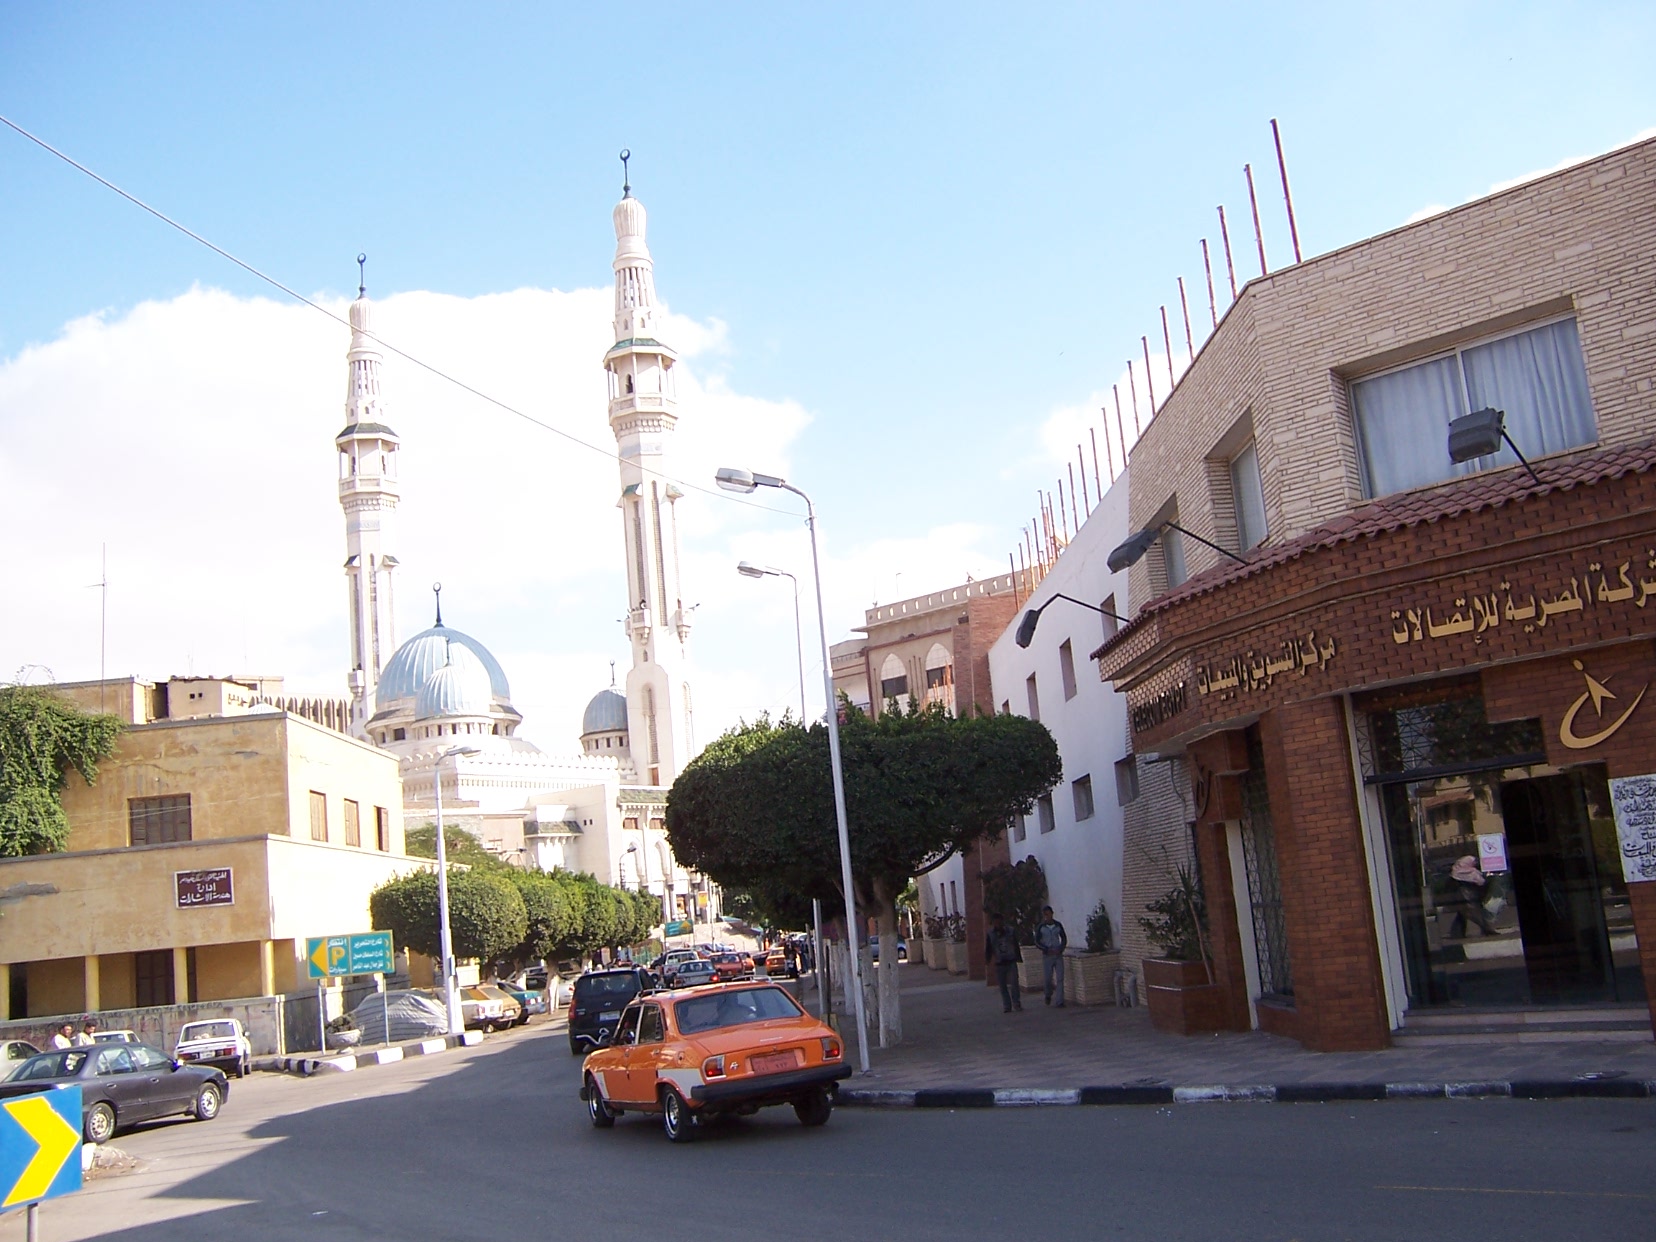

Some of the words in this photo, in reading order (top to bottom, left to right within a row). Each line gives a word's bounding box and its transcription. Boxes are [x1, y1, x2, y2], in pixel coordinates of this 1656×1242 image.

[1391, 591, 1500, 645] للإتصالات
[1500, 571, 1592, 634] المصرية
[1246, 640, 1299, 690] التسويق
[1300, 631, 1335, 676] مركز
[1197, 657, 1249, 700] والمبيعات
[331, 946, 346, 967] P
